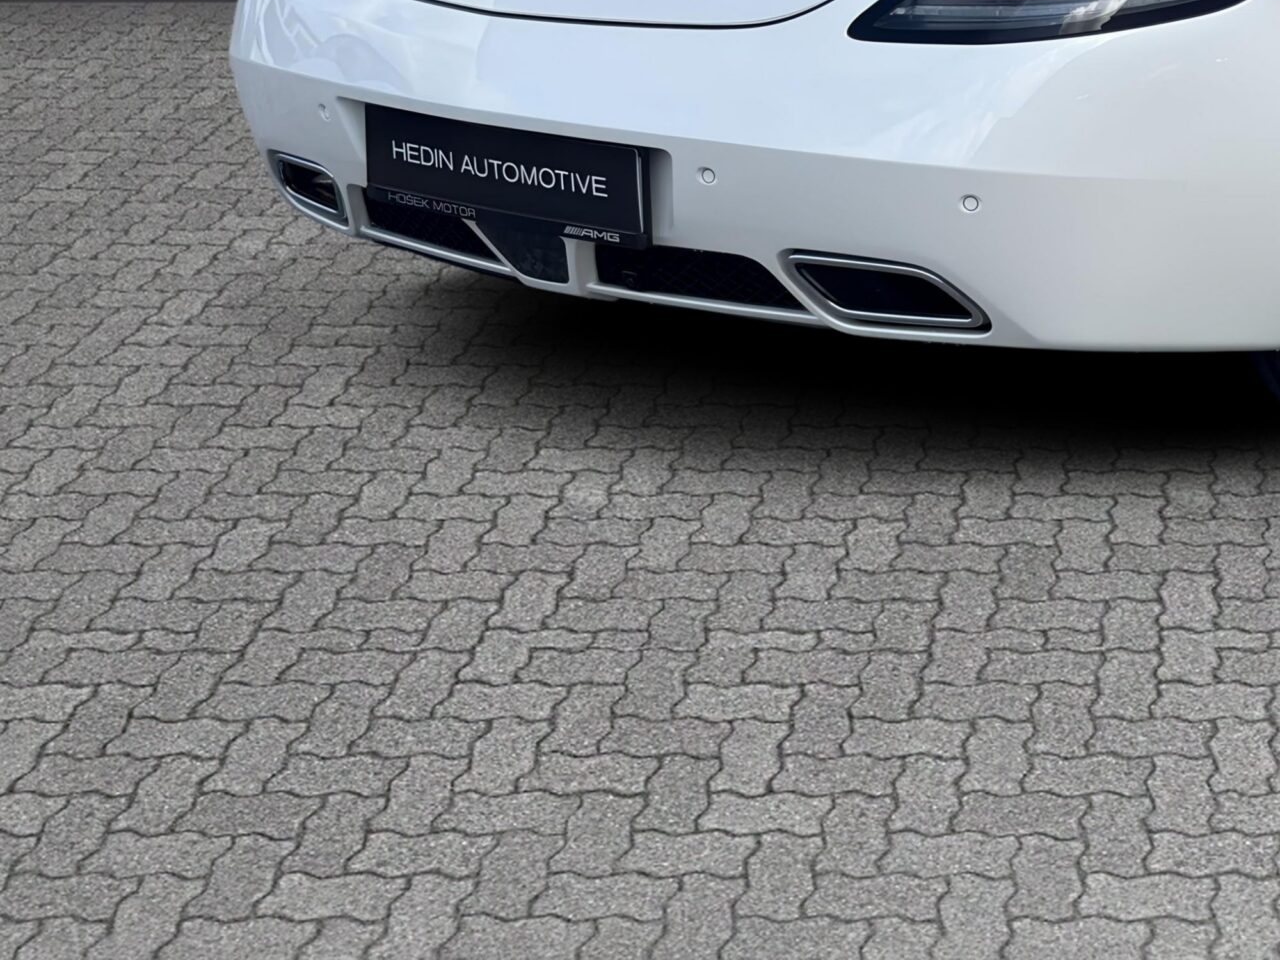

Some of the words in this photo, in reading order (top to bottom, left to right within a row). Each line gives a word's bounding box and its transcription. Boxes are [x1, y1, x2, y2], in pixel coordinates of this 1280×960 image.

[391, 140, 454, 172] HEDIN
[460, 154, 608, 198] AUTOMOTIVE
[432, 200, 477, 219] MOTOR
